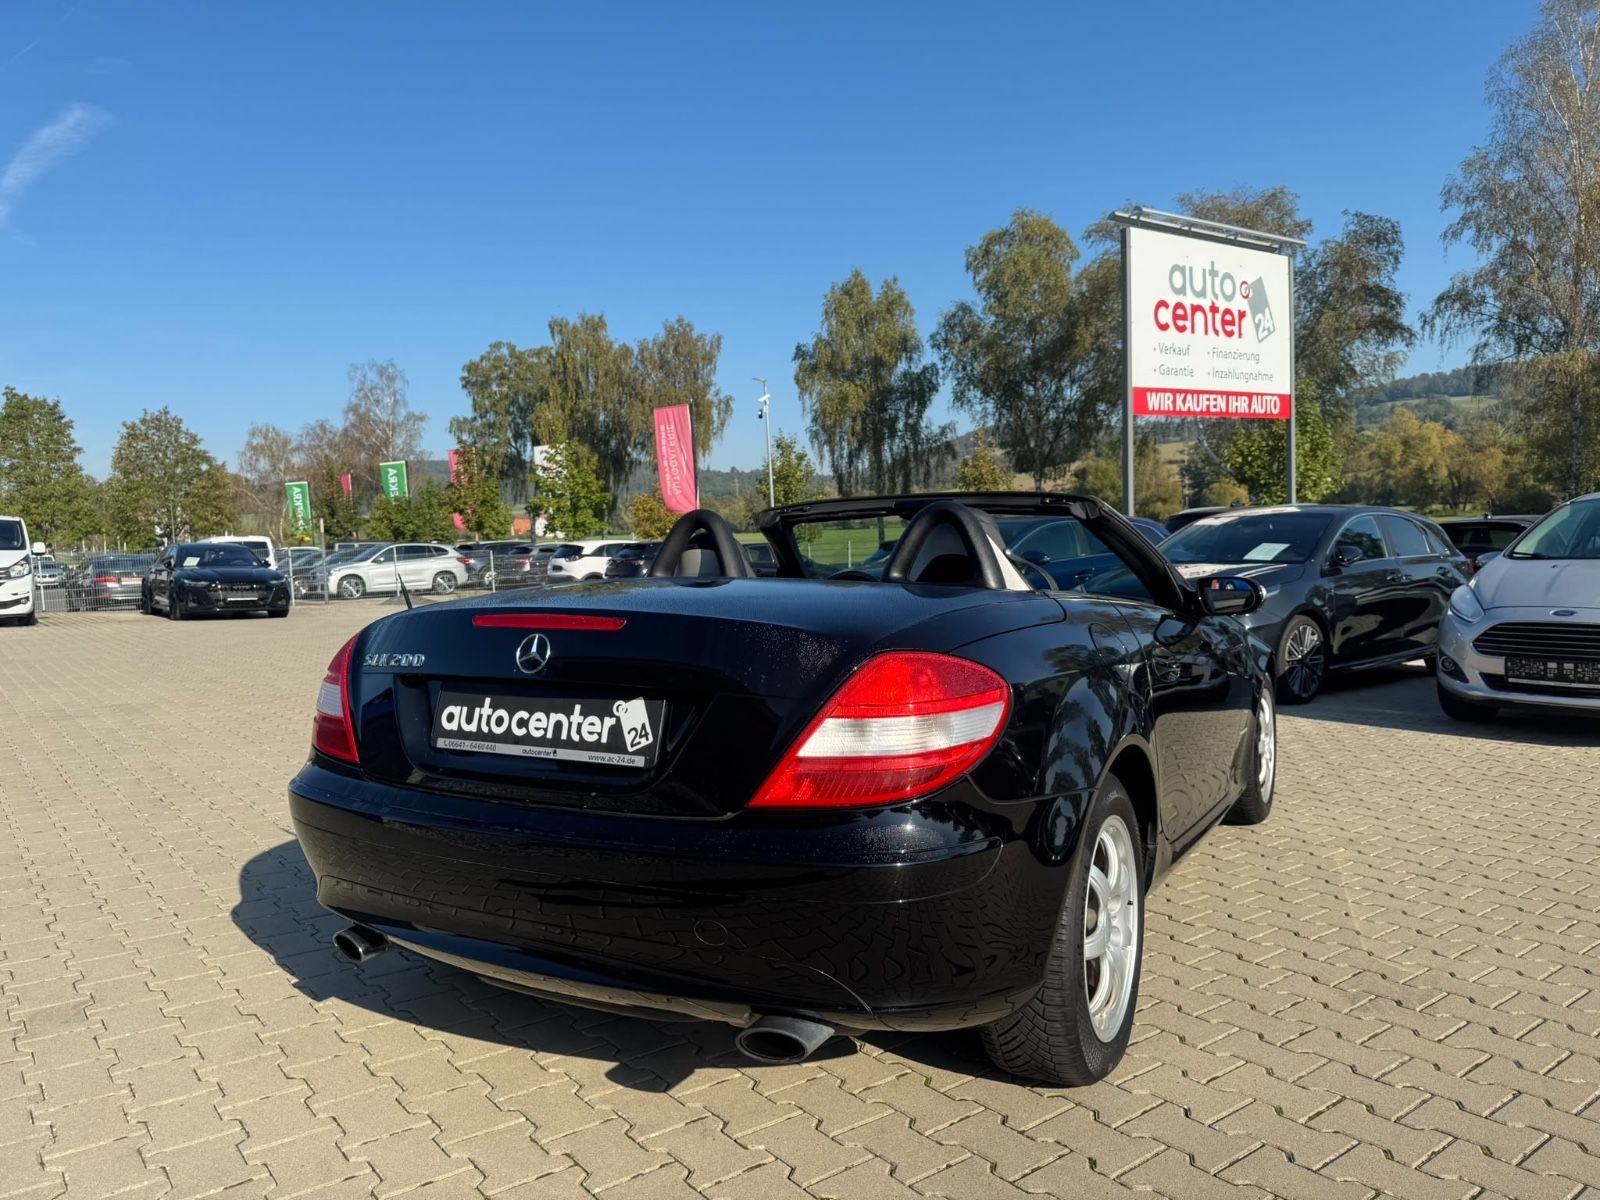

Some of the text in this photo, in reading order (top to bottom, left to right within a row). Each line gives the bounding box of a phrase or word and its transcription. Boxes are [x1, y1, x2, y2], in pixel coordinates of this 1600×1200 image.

[1168, 261, 1236, 302] auto
[1154, 299, 1274, 340] center 24
[1158, 342, 1191, 357] Verkauf
[1212, 347, 1260, 364] Finanzierung
[1159, 365, 1194, 378] Garantie
[1212, 368, 1273, 383] Inzahlungnahme
[1146, 391, 1280, 415] WIR KAUFEN IHR AUTO
[440, 697, 650, 749] autocenter 24
[522, 748, 552, 757] autocenter
[587, 754, 636, 765] www.ac-24.de
